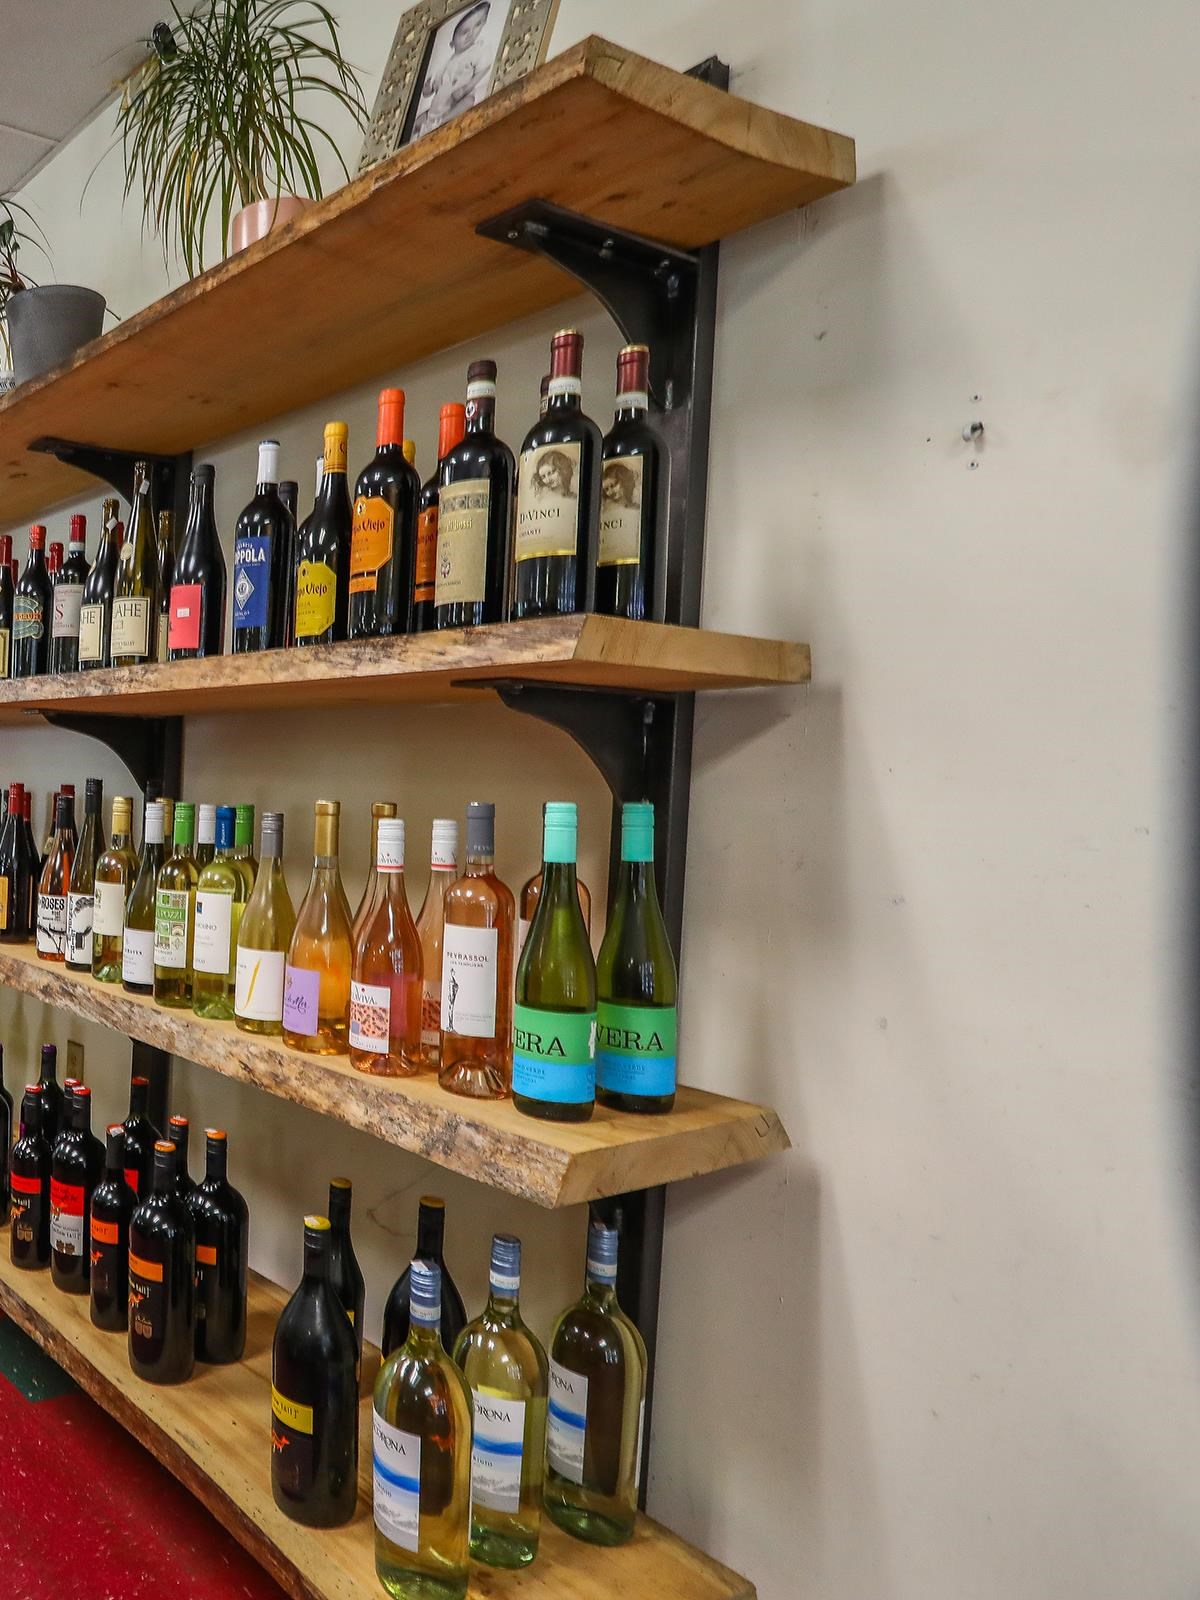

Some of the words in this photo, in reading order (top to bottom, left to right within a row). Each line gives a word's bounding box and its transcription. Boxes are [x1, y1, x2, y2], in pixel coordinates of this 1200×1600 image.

[362, 519, 386, 534] Viejo
[306, 582, 328, 597] Viejo
[41, 896, 65, 911] ROSES
